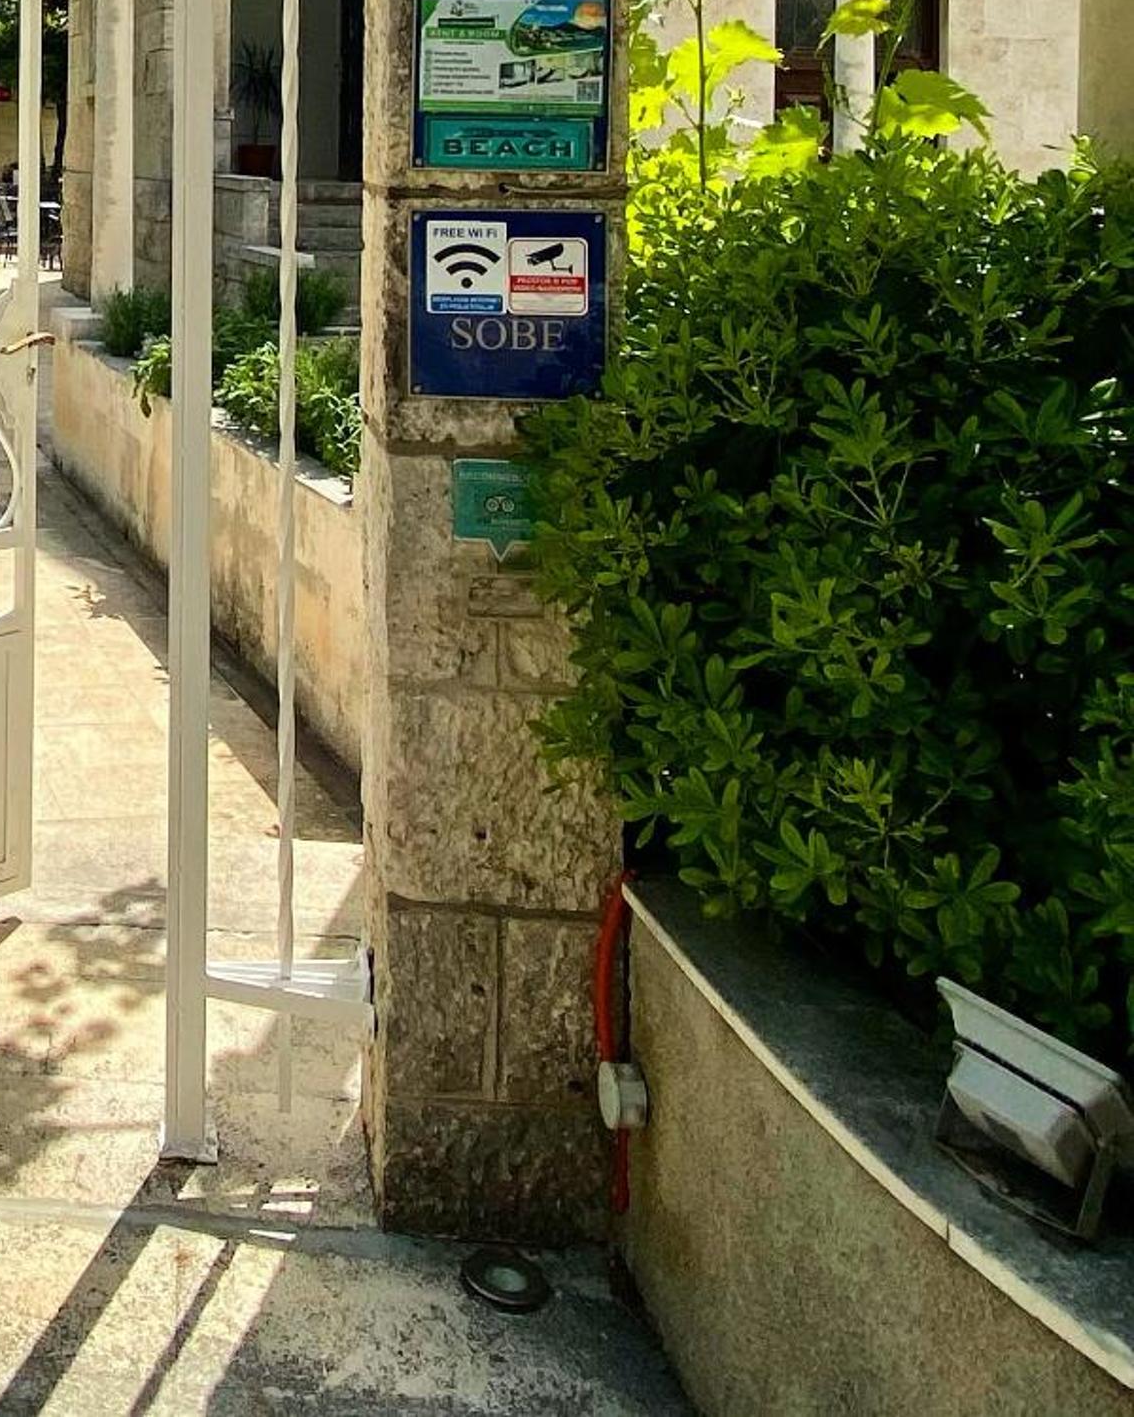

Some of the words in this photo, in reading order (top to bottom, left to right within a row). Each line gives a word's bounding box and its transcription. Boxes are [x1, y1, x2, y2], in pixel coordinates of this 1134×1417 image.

[443, 138, 573, 158] BEACH
[433, 227, 464, 239] FREE
[450, 318, 566, 350] SOBE
